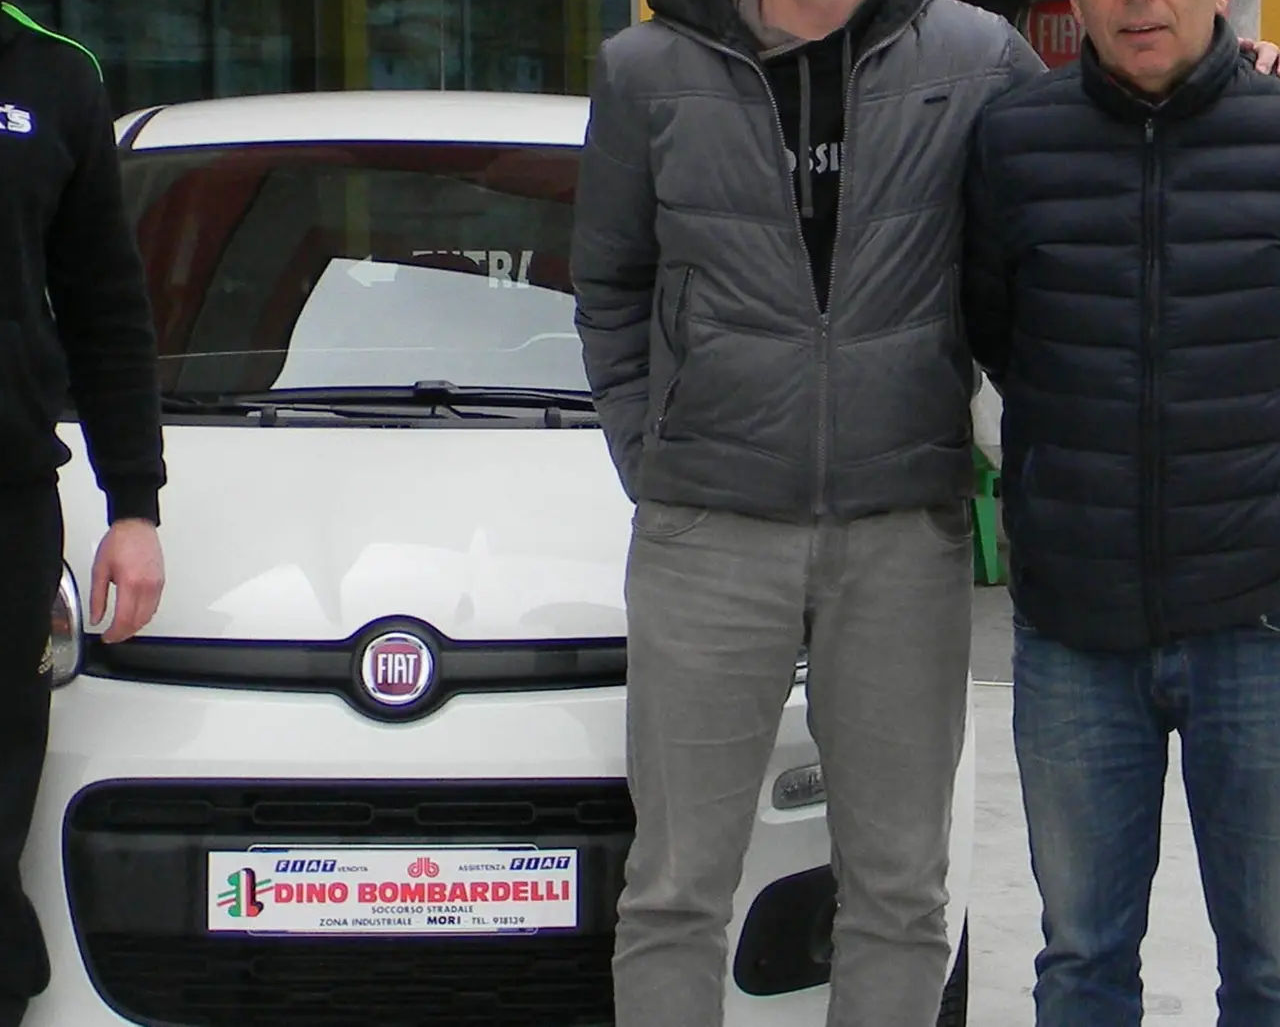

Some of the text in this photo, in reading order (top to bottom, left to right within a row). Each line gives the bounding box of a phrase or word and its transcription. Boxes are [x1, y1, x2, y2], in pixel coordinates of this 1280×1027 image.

[1038, 13, 1085, 54] FIA
[377, 654, 418, 685] FIAT
[276, 860, 337, 873] FIAT
[458, 856, 571, 872] ASSISTENZA FIAT
[274, 880, 570, 904] DINO BOMBARDELLI
[371, 905, 473, 914] SOCCORSO STRADALE
[319, 917, 348, 927] ZONA
[351, 917, 412, 926] INDUSTRIALE
[426, 916, 461, 925] MORI
[472, 916, 489, 925] TEL.
